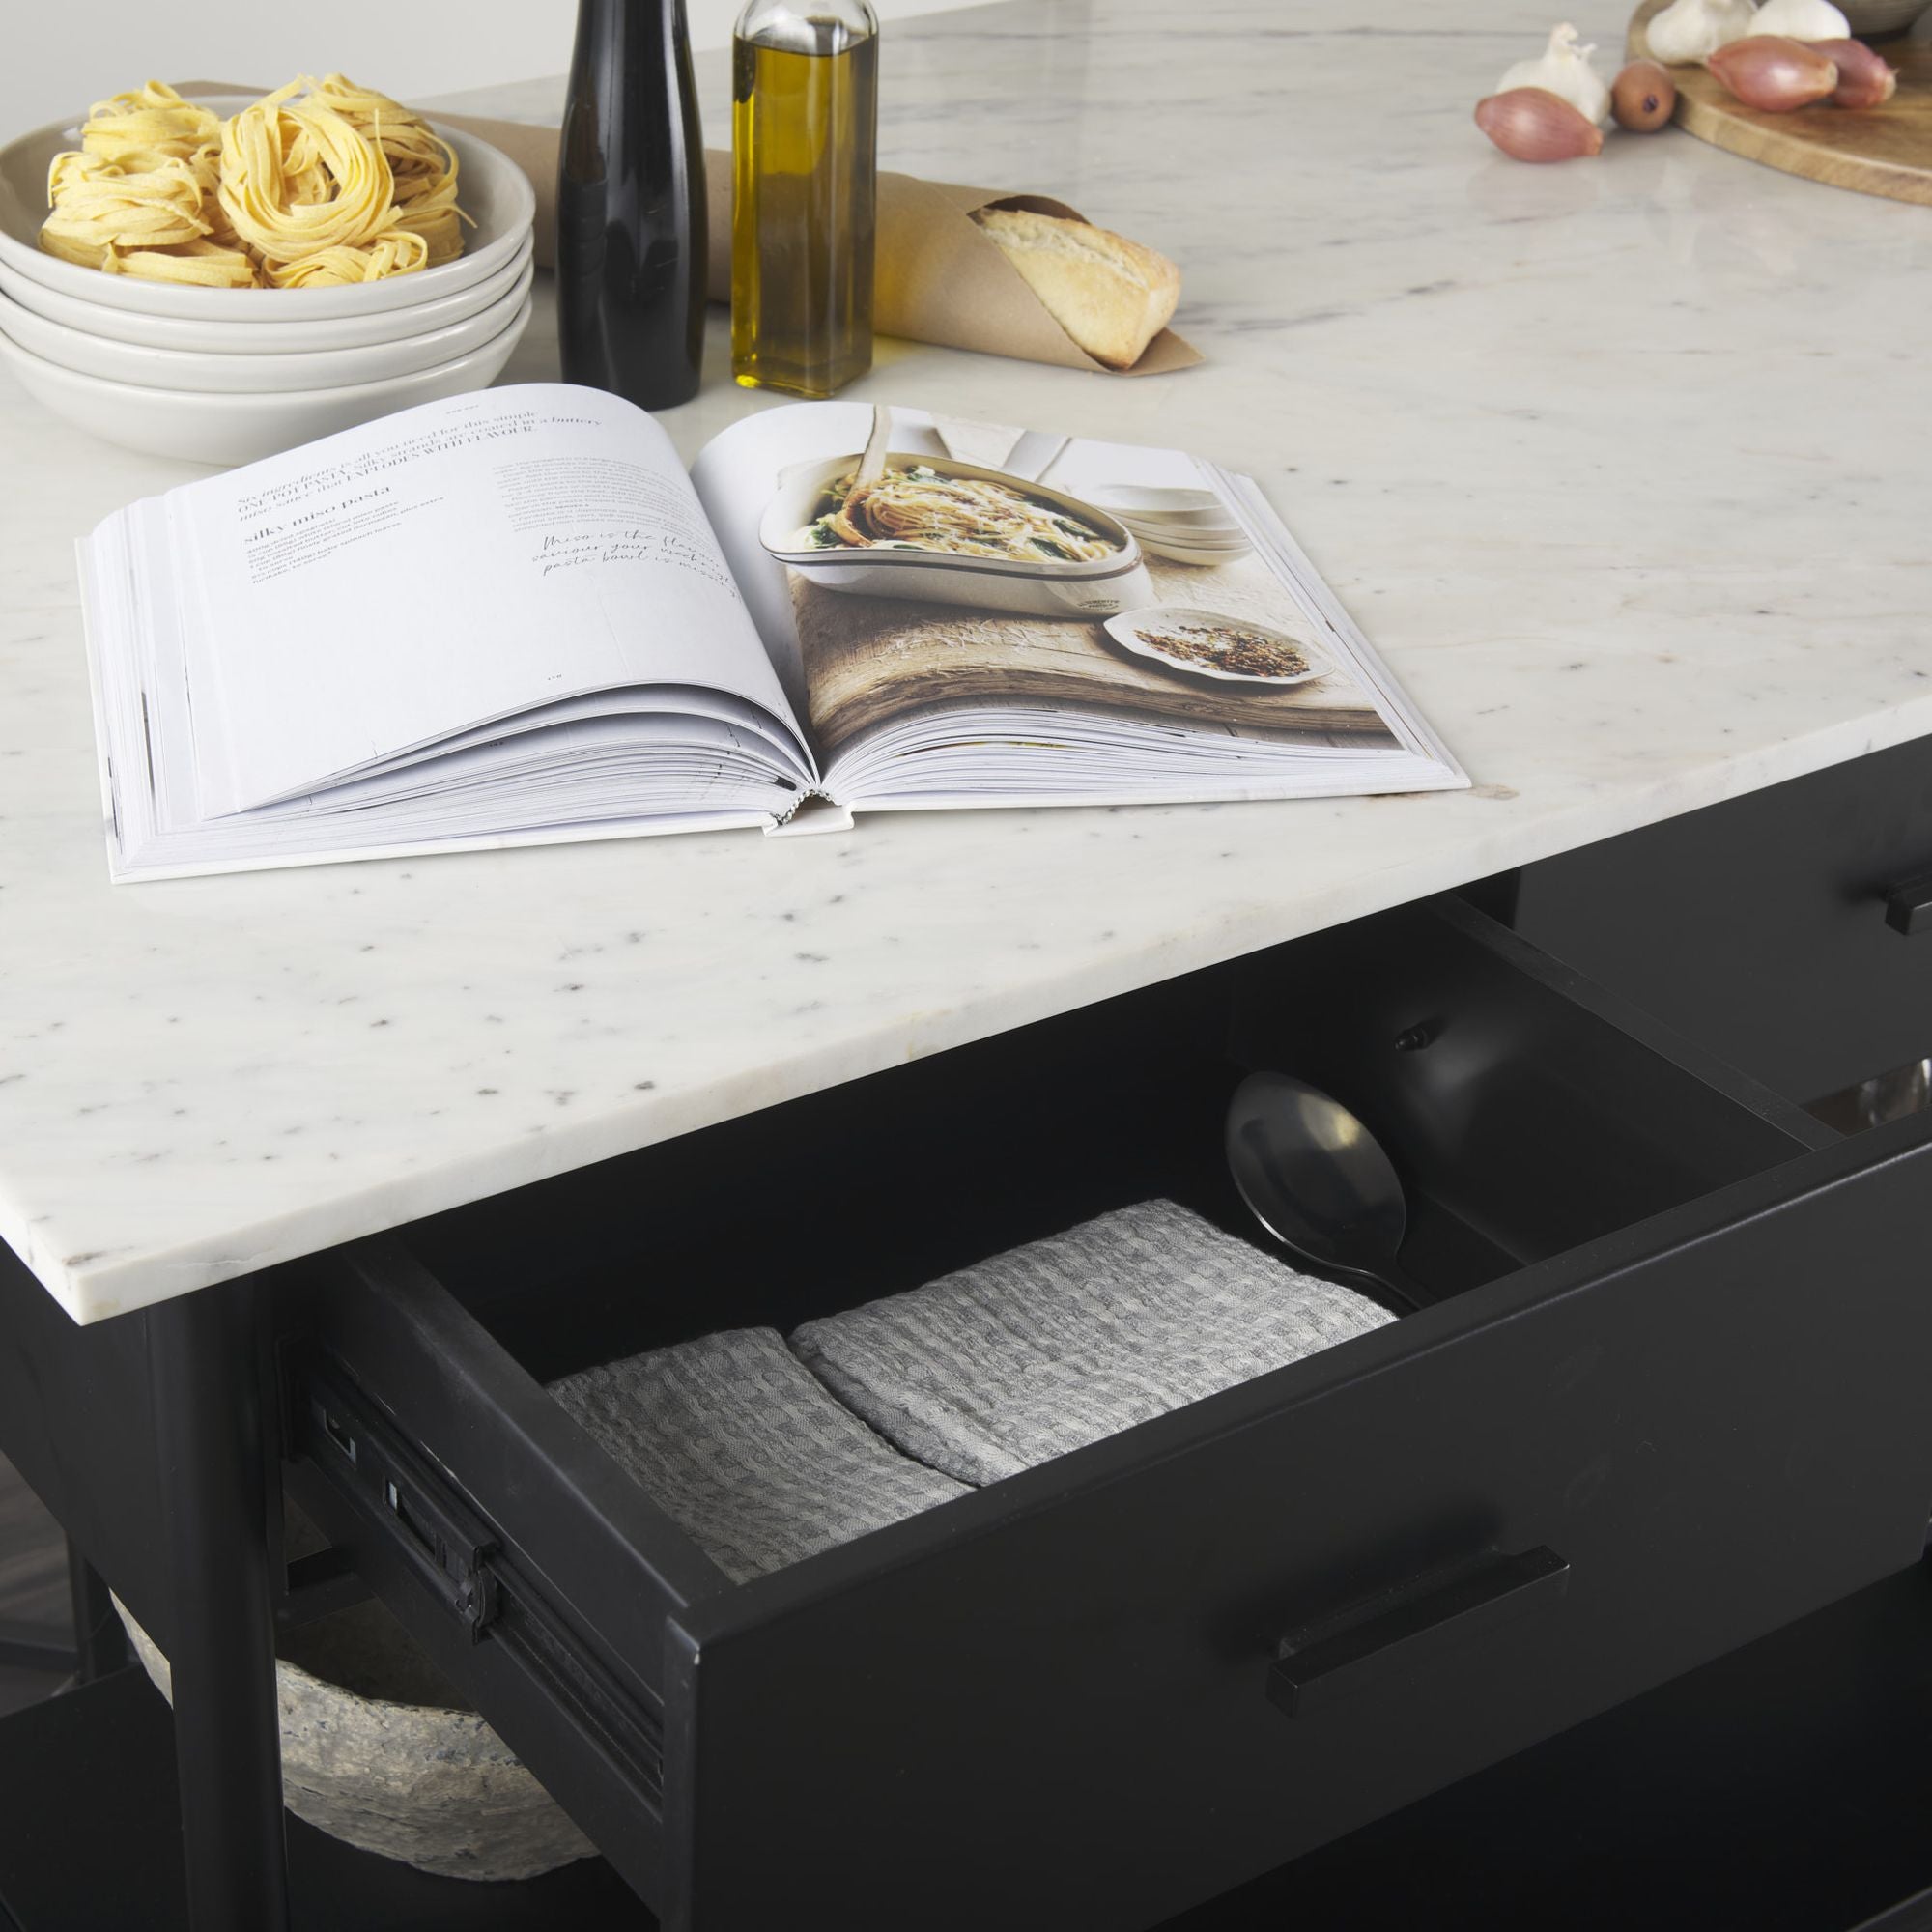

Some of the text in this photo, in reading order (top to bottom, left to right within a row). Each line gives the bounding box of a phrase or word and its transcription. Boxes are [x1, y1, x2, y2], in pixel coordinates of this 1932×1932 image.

[346, 451, 420, 482] EXPLODES
[423, 438, 464, 455] WITH
[244, 485, 391, 542] silky miso pasta
[531, 544, 602, 562] saviour
[611, 543, 651, 554] your
[543, 534, 591, 550] Miso
[624, 529, 657, 539] the
[543, 555, 596, 576] pasta
[602, 550, 648, 562] bowl
